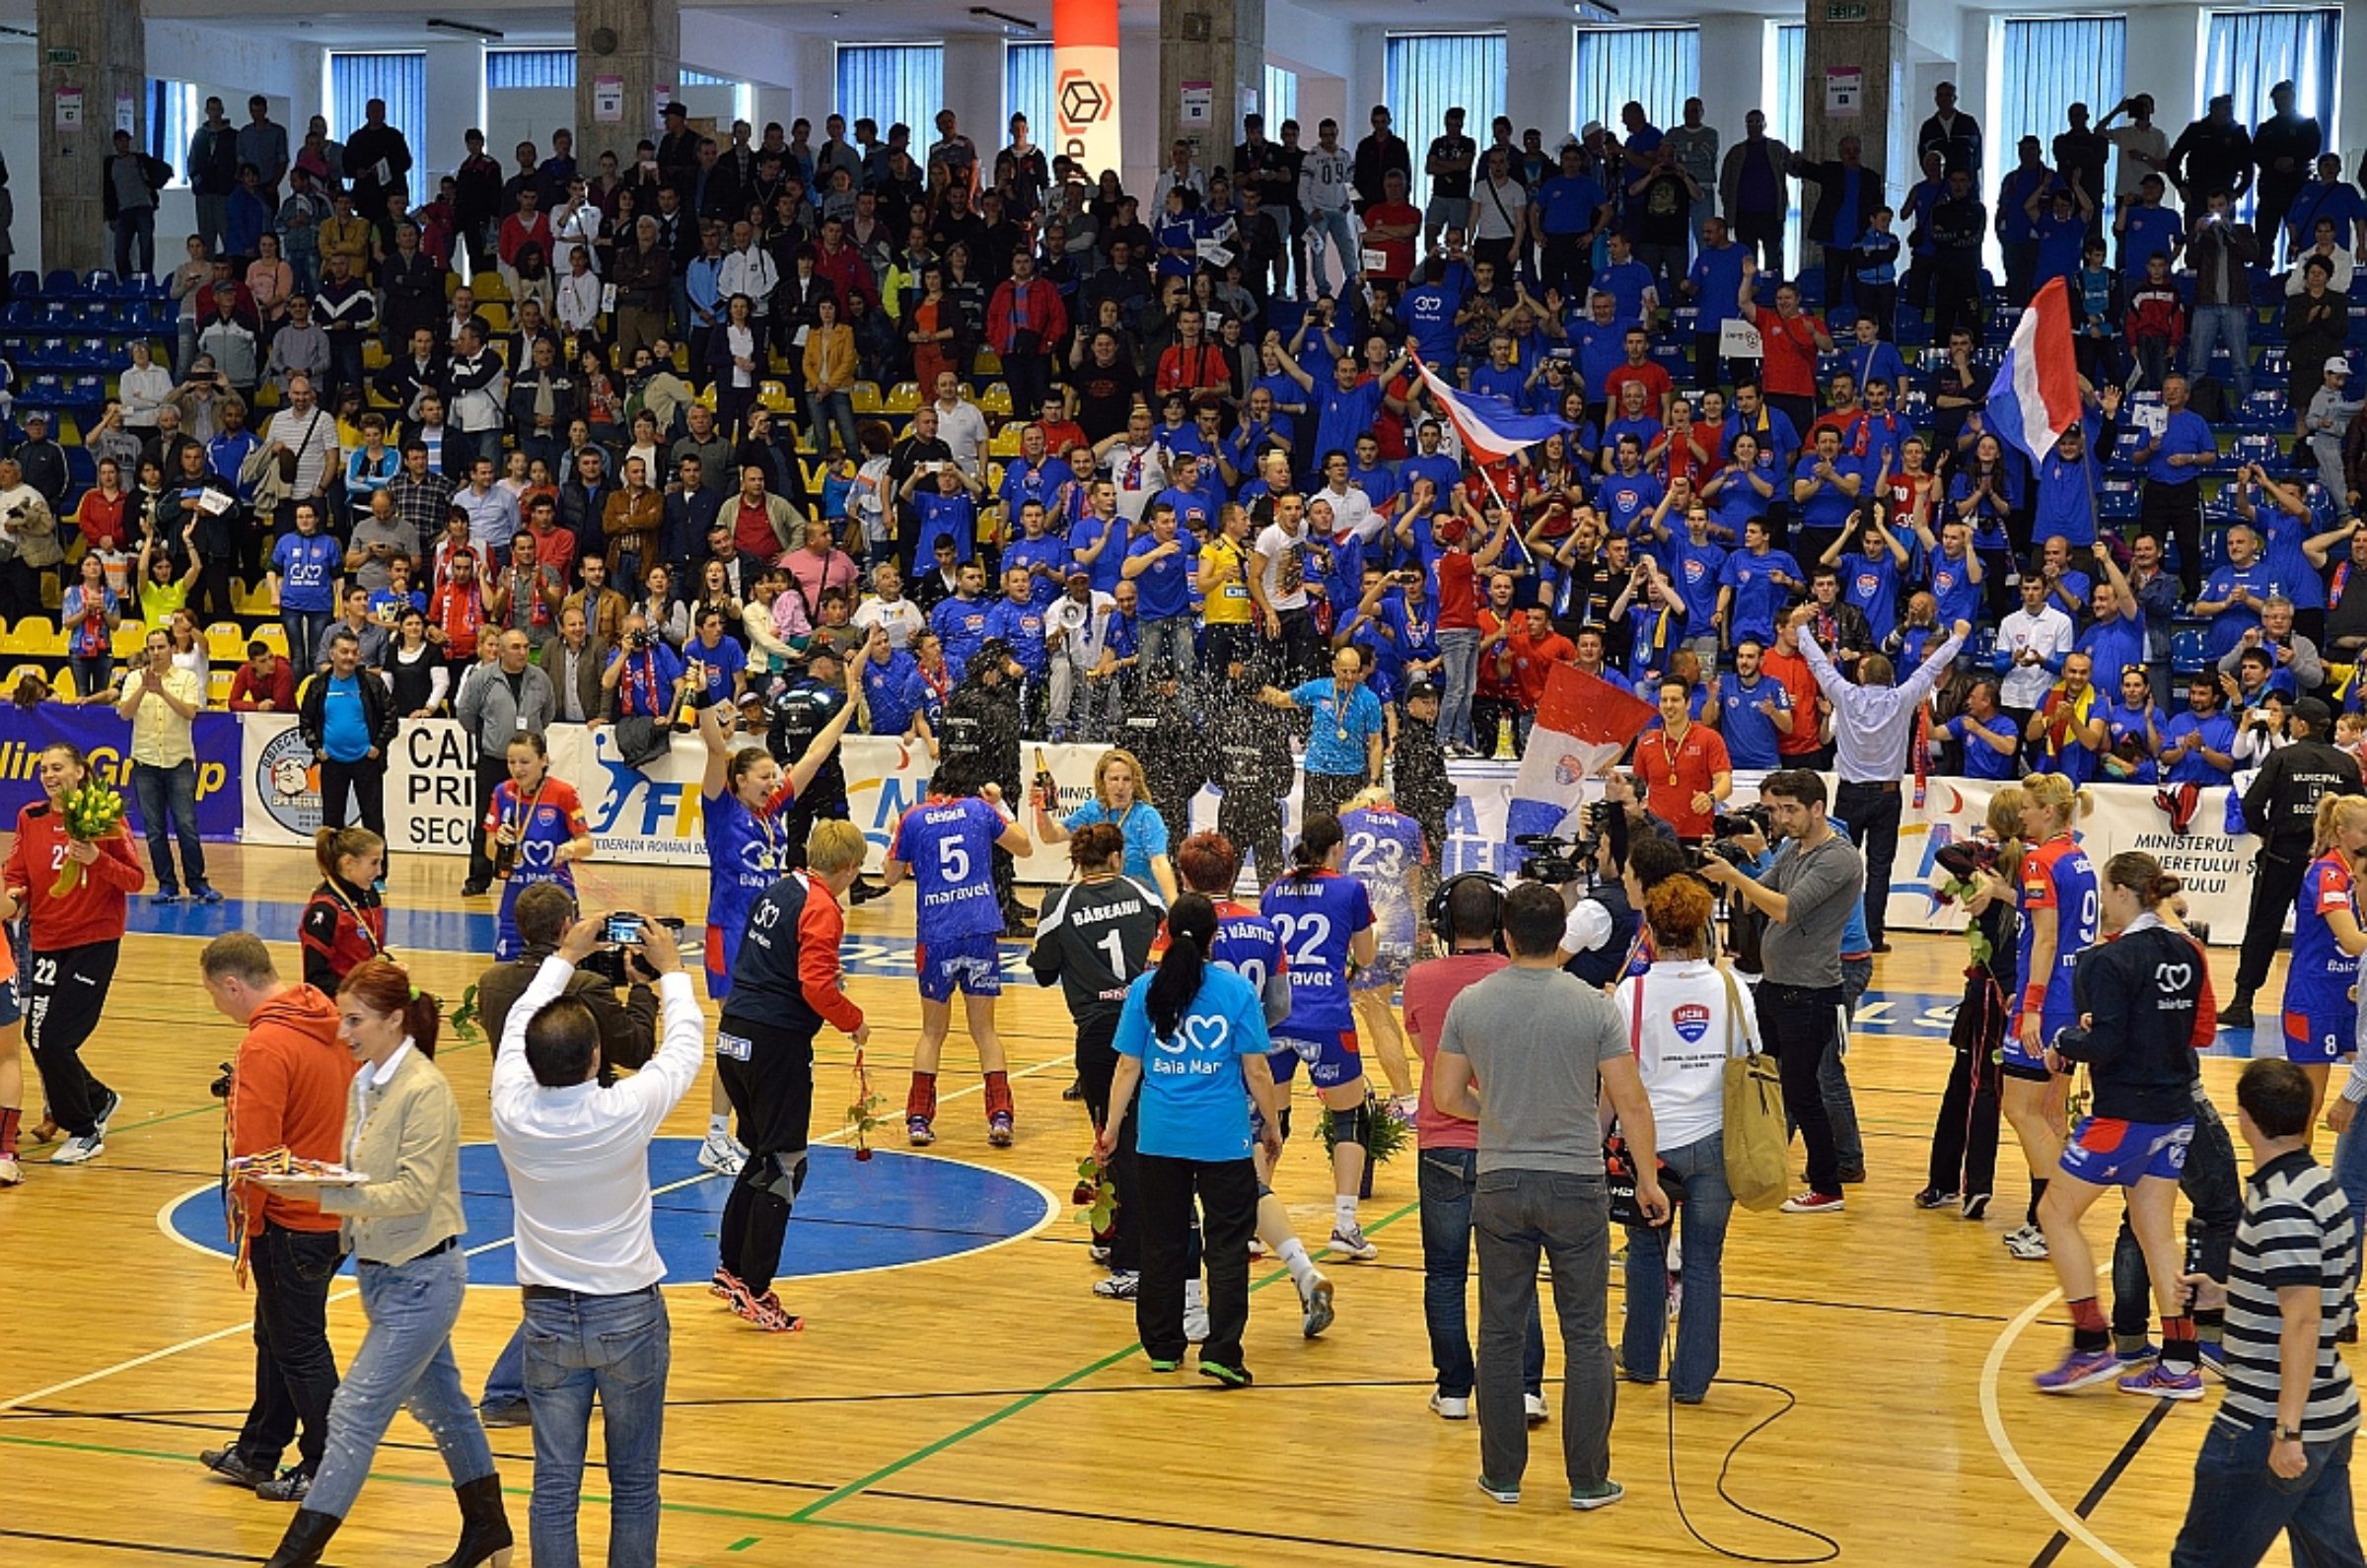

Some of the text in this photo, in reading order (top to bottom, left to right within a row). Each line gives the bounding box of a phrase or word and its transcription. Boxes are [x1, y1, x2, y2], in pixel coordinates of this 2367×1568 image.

[87, 747, 227, 801] Grp
[939, 834, 969, 882] 5
[1348, 831, 1403, 878] 23
[2134, 833, 2236, 853] MINISTERUL
[925, 882, 990, 906] maravet
[2078, 890, 2098, 944] 9
[1097, 928, 1126, 981] 1
[1271, 913, 1331, 965] 22
[34, 957, 57, 986] 22
[1153, 1057, 1186, 1075] Baia
[2325, 1033, 2336, 1055] 8
